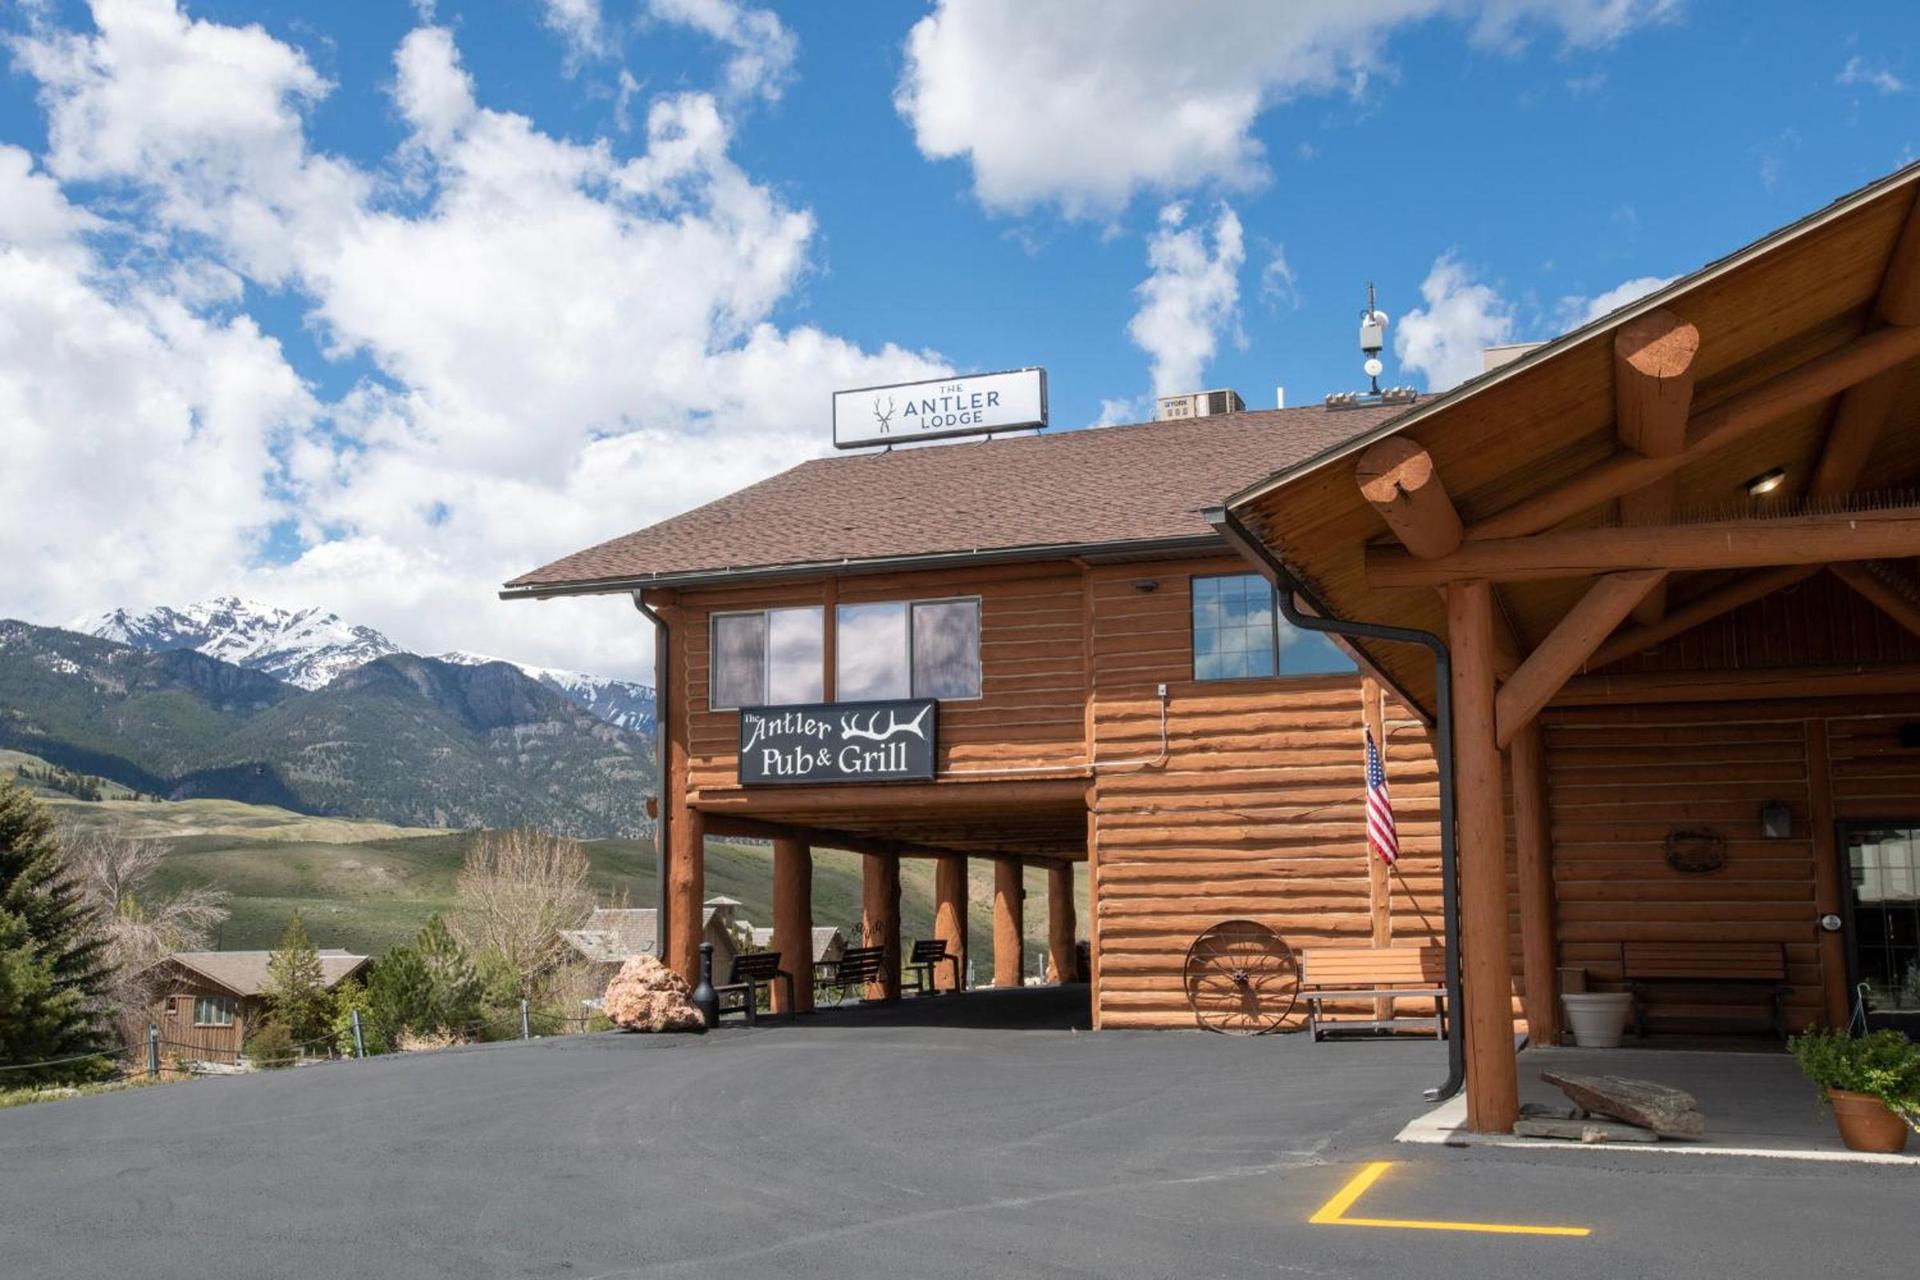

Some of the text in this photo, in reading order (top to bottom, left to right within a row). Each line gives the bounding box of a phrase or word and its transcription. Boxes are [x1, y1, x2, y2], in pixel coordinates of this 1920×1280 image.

[940, 384, 963, 394] THE
[904, 391, 999, 416] ANTLER
[921, 411, 983, 429] LODGE
[742, 712, 832, 752] The Antler
[761, 742, 908, 775] Pub & Grill
